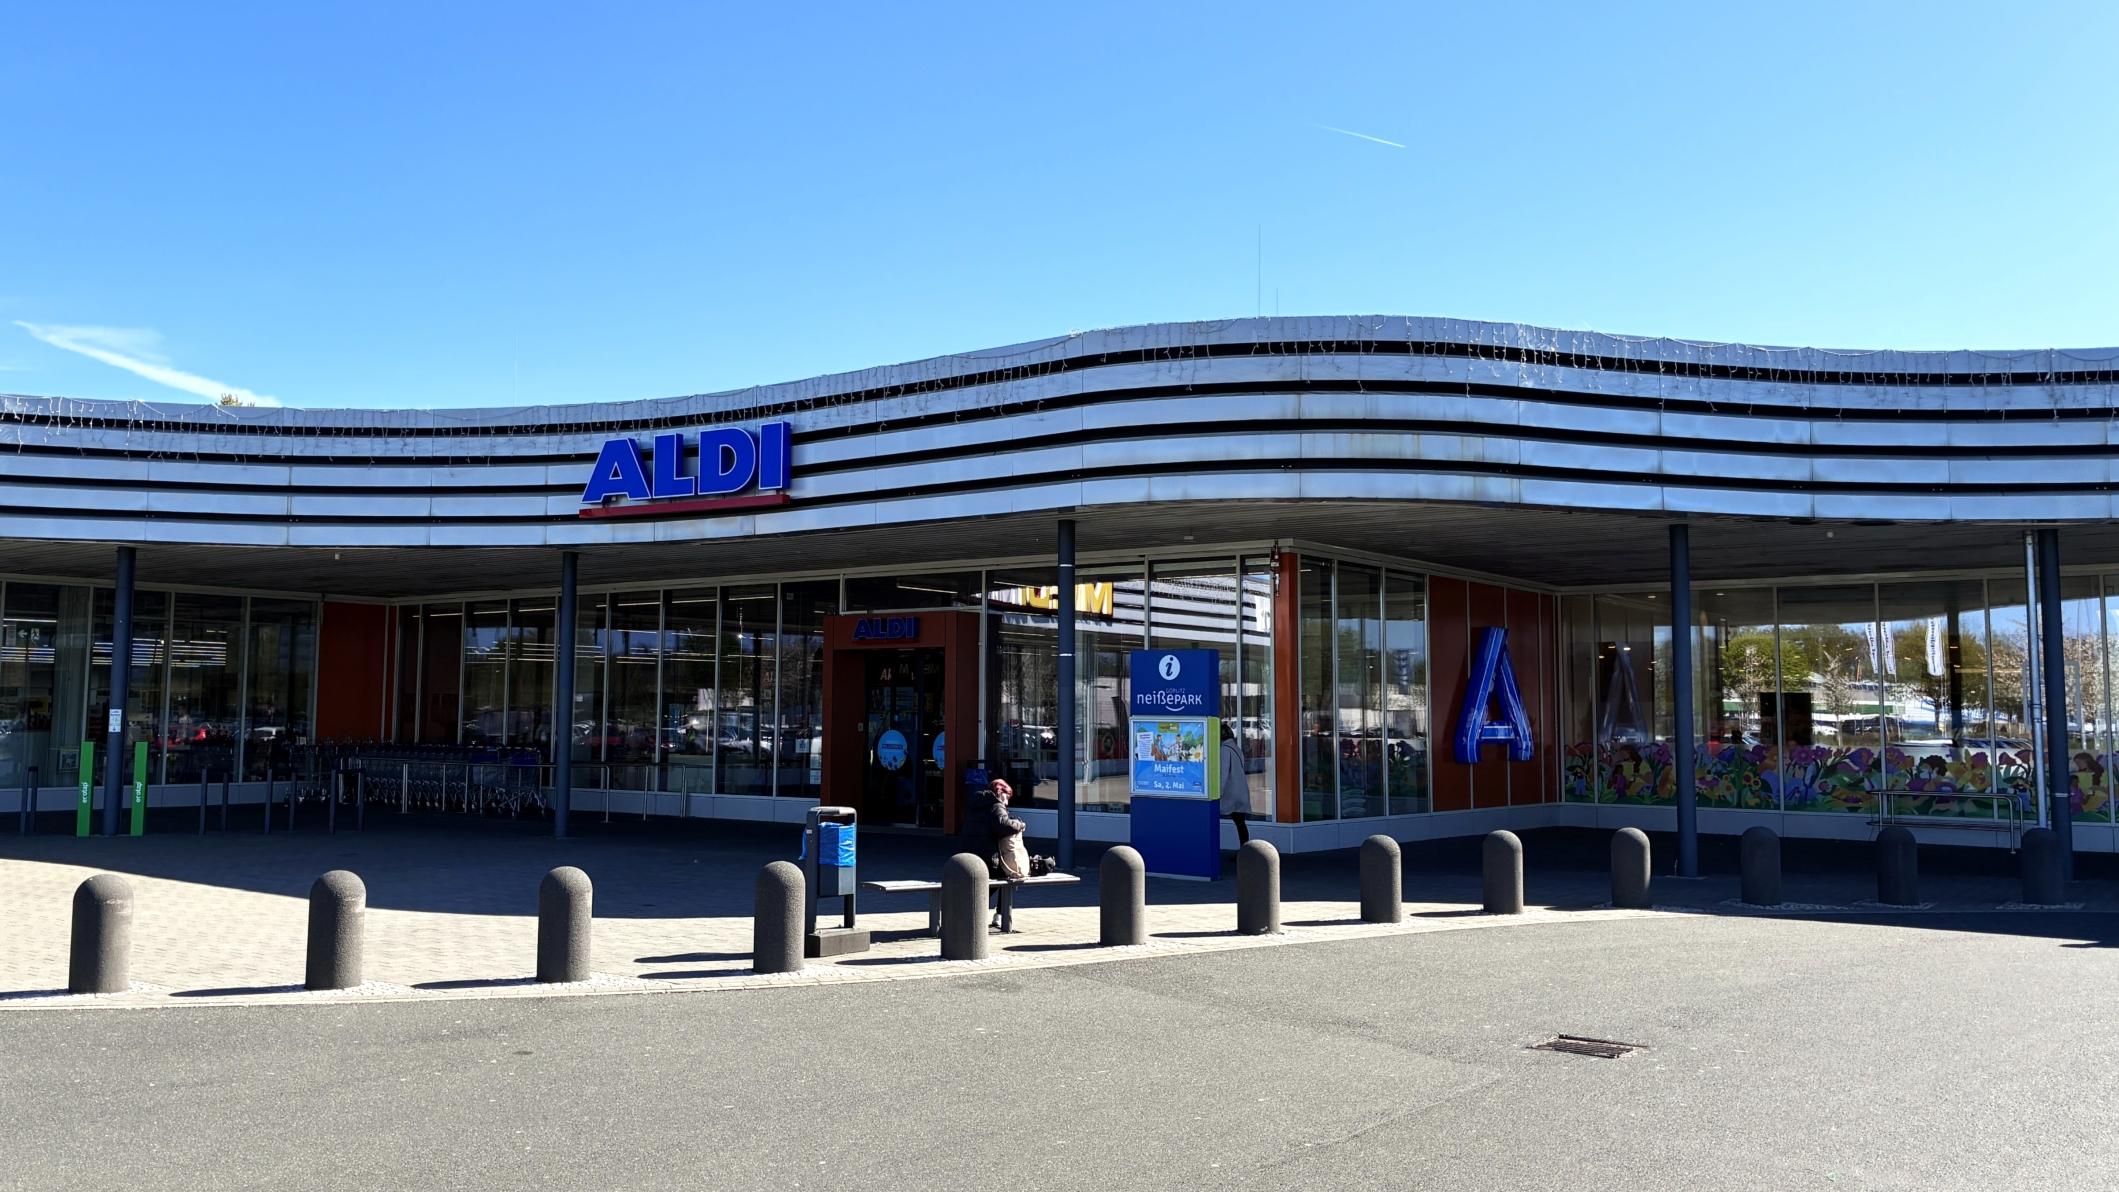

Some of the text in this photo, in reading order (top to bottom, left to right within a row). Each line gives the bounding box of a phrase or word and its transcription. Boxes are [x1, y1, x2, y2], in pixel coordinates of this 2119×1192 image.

[581, 421, 788, 504] ALDI
[852, 615, 917, 641] ALDI
[1154, 763, 1185, 774] Maifest
[1172, 781, 1185, 789] Mai
